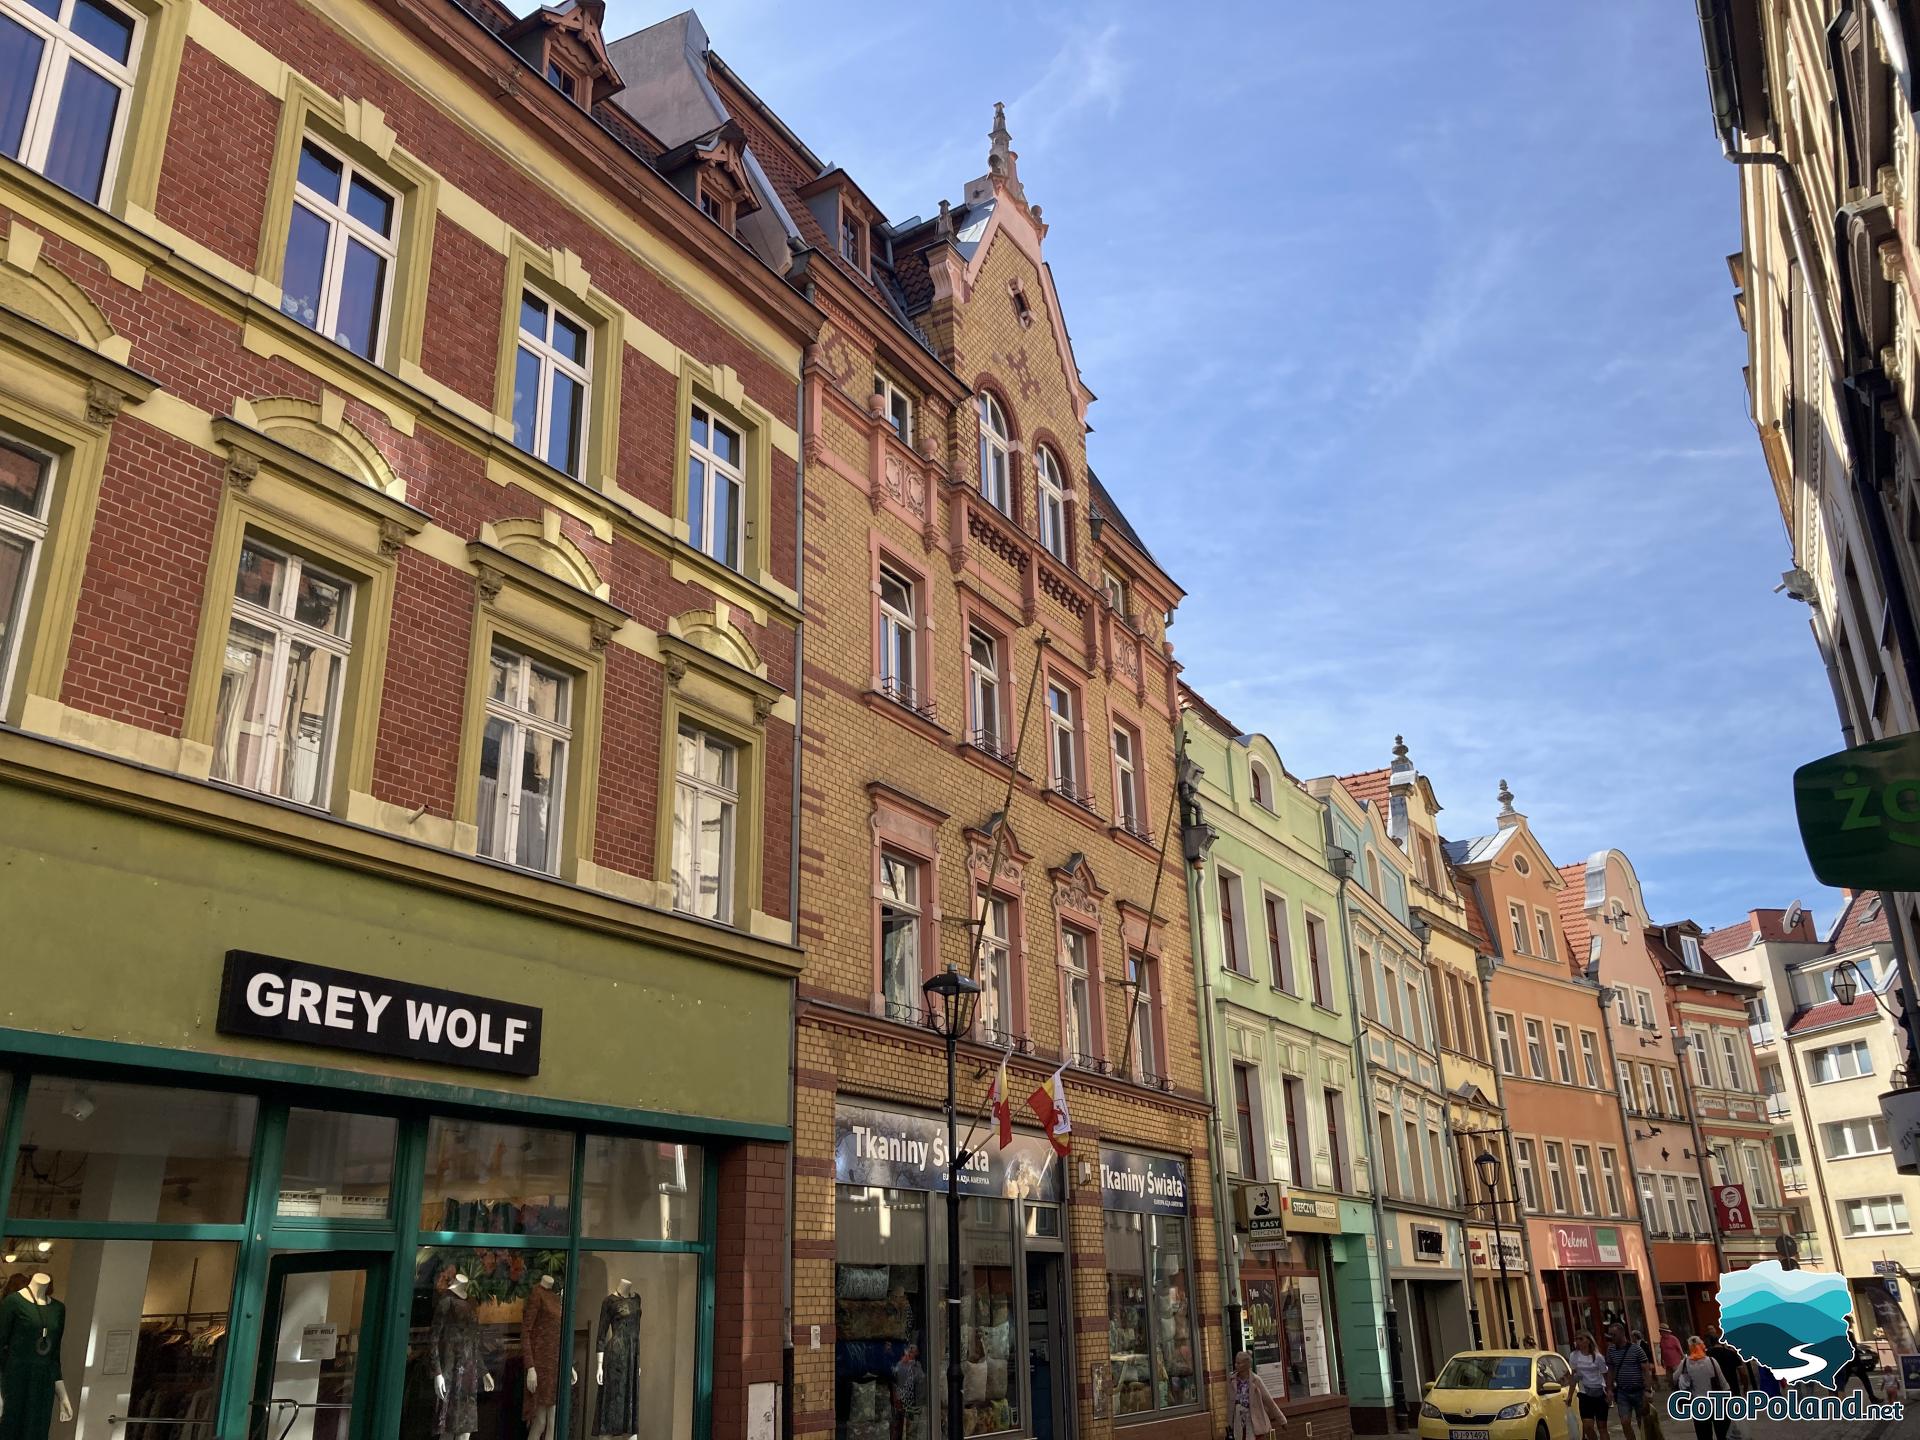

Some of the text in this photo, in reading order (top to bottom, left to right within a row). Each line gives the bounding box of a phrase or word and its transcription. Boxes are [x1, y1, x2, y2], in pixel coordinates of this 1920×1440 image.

[246, 972, 528, 1055] GREY WOLF
[852, 1126, 929, 1172] Tkaniny
[1100, 1163, 1183, 1198] Tkaniny Świata
[1259, 1220, 1280, 1228] KASY
